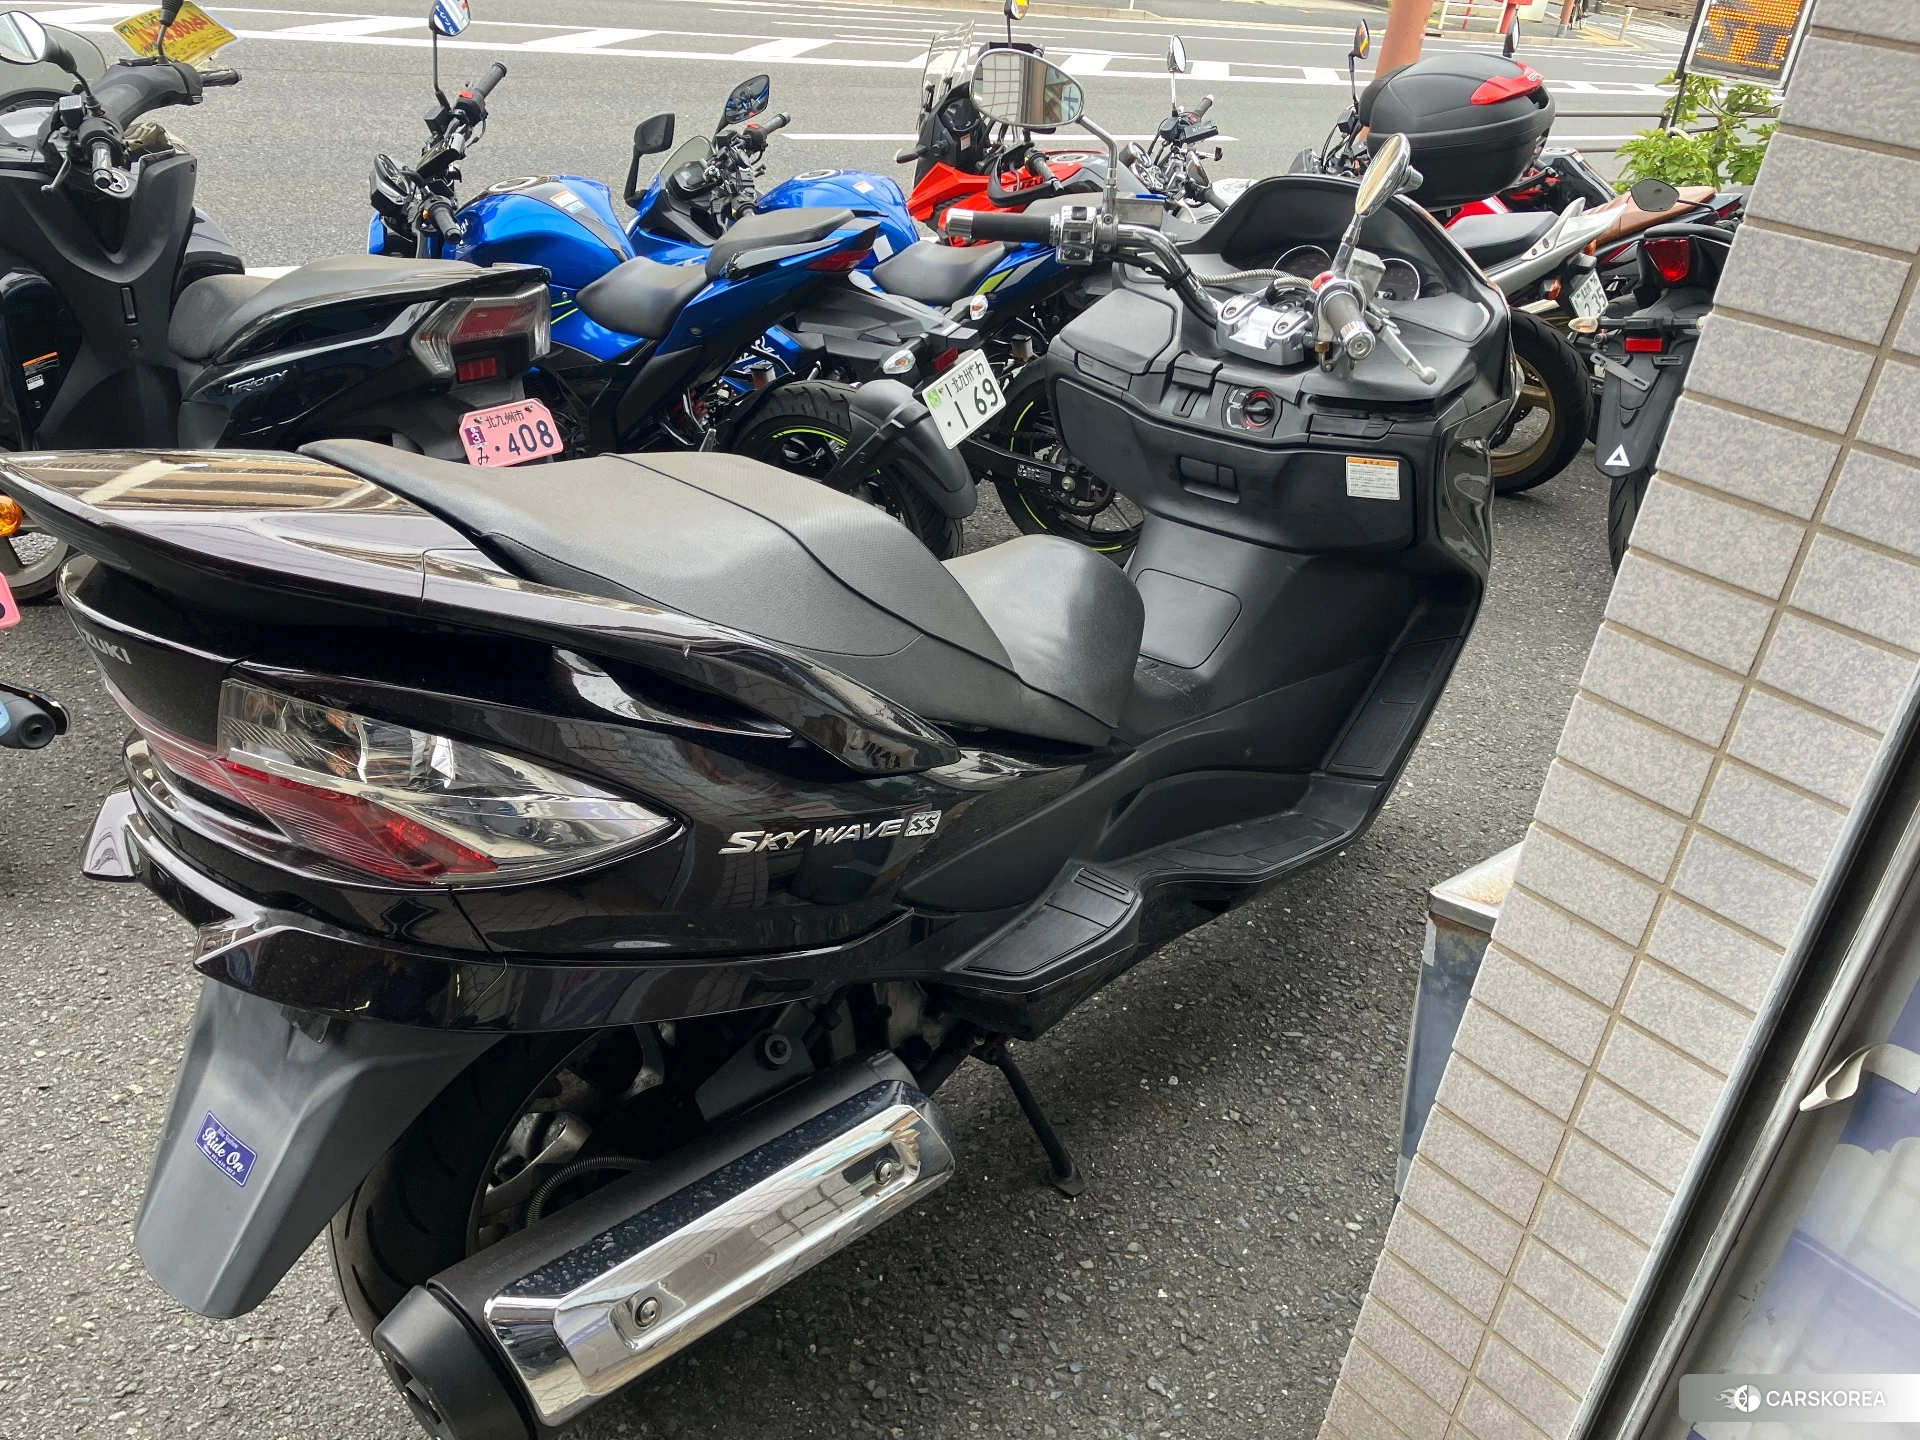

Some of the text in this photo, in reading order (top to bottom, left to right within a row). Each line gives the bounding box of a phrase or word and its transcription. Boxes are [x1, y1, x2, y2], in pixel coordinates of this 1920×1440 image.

[485, 409, 525, 429] 北九州市
[477, 446, 490, 466] み
[82, 629, 132, 664] ZUKI
[718, 829, 811, 855] SKY
[812, 818, 905, 847] WAVE
[202, 1127, 245, 1173] Ride On
